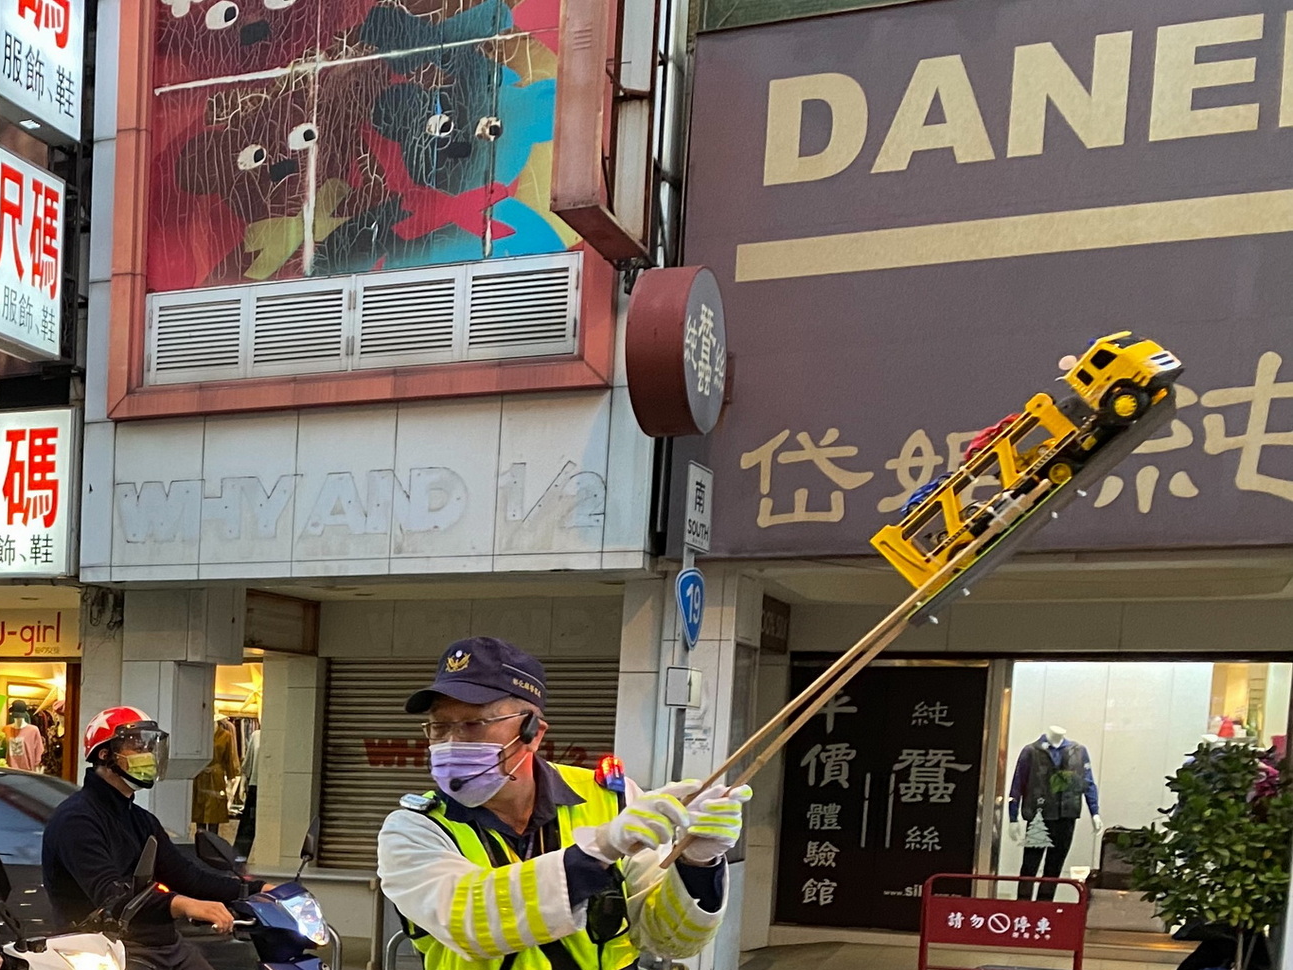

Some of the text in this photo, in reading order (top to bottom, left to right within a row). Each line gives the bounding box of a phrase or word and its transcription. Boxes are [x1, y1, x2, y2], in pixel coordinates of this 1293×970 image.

[763, 11, 1293, 187] DANE
[301, 466, 469, 540] AND
[694, 480, 707, 514] 南
[687, 518, 710, 542] SOUTH
[685, 582, 702, 625] 19
[363, 738, 429, 768] WH
[947, 911, 1052, 934] 請勿 停車
